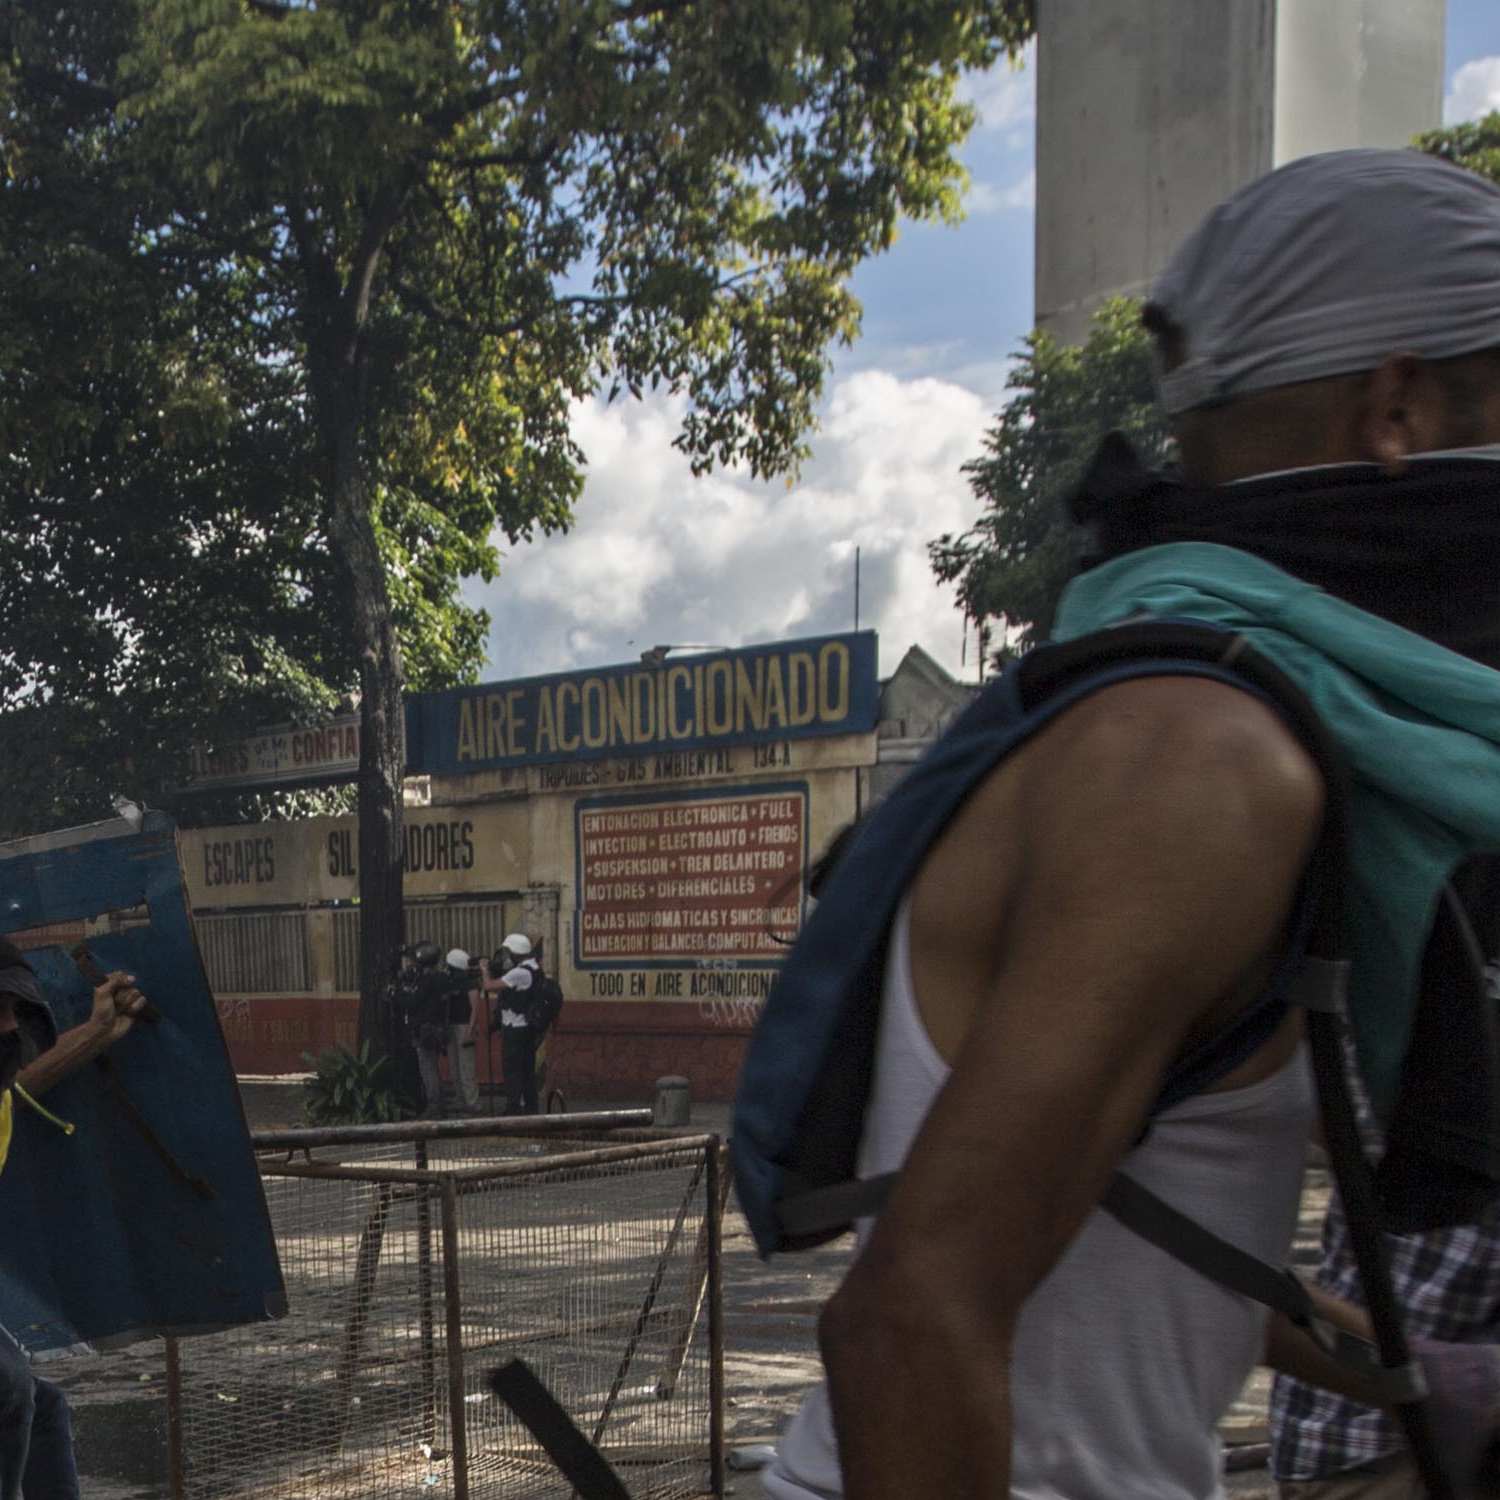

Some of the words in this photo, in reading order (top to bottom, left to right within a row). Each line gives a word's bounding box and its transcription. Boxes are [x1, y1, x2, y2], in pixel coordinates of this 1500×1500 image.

[457, 689, 526, 762] AIRE
[535, 641, 849, 754] ACONDICIONADO
[616, 760, 646, 782] GAS
[653, 751, 734, 779] AMBIENTAL
[585, 812, 658, 833] ENTONACION
[663, 804, 748, 827] ELECTRONICA
[760, 800, 793, 820] FUEL
[586, 836, 647, 857] INYECTION
[659, 829, 746, 850] ELECTROAUTO
[758, 825, 798, 844] FRENOS
[203, 837, 275, 887] ESCAPES
[593, 858, 668, 878] SUSPENSION
[679, 855, 711, 873] TREN
[714, 850, 785, 871] DELANTERO
[586, 881, 645, 901] MOTORES
[658, 876, 755, 899] DIFERENCIALES
[584, 912, 624, 930] CAJAS
[720, 907, 729, 927] Y
[730, 906, 797, 926] SINCRONICAS
[584, 934, 644, 953] ALINEACION
[651, 932, 703, 951] BALANCEO
[589, 972, 624, 997] TODO
[630, 972, 646, 997] EN
[655, 972, 683, 997] AIRE
